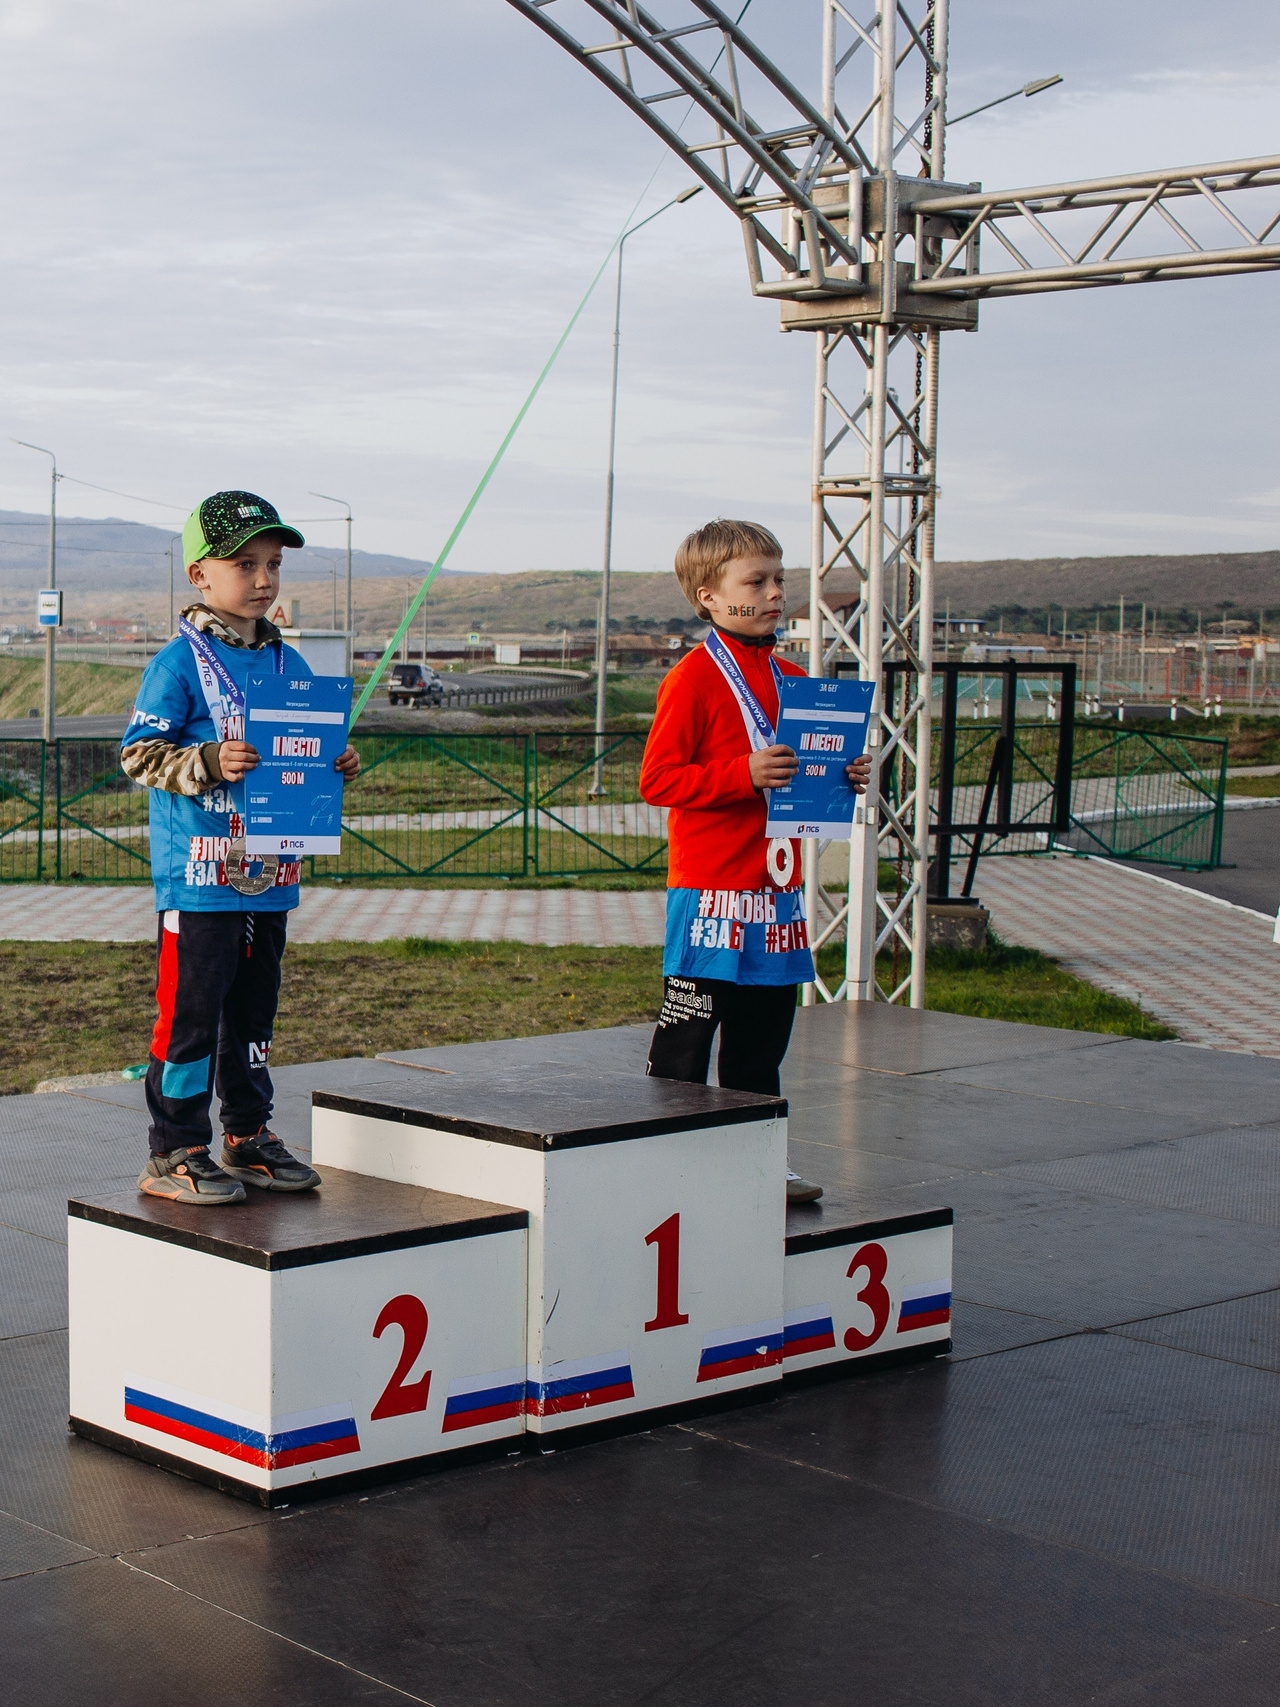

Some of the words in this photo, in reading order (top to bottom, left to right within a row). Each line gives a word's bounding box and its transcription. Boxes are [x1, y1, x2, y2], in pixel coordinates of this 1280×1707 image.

[202, 665, 213, 687] ПСБ
[213, 661, 239, 698] ОБЛАСТЬ
[734, 676, 767, 729] САХАЛИНСКАЯ
[132, 710, 172, 732] ПСБ
[281, 737, 321, 758] МЕСТО
[810, 734, 845, 752] МЕСТО
[281, 772, 297, 785] 500
[297, 772, 304, 785] М
[805, 765, 819, 776] 500
[644, 1212, 689, 1332] 1
[844, 1242, 890, 1351] 3
[370, 1294, 433, 1421] 2
